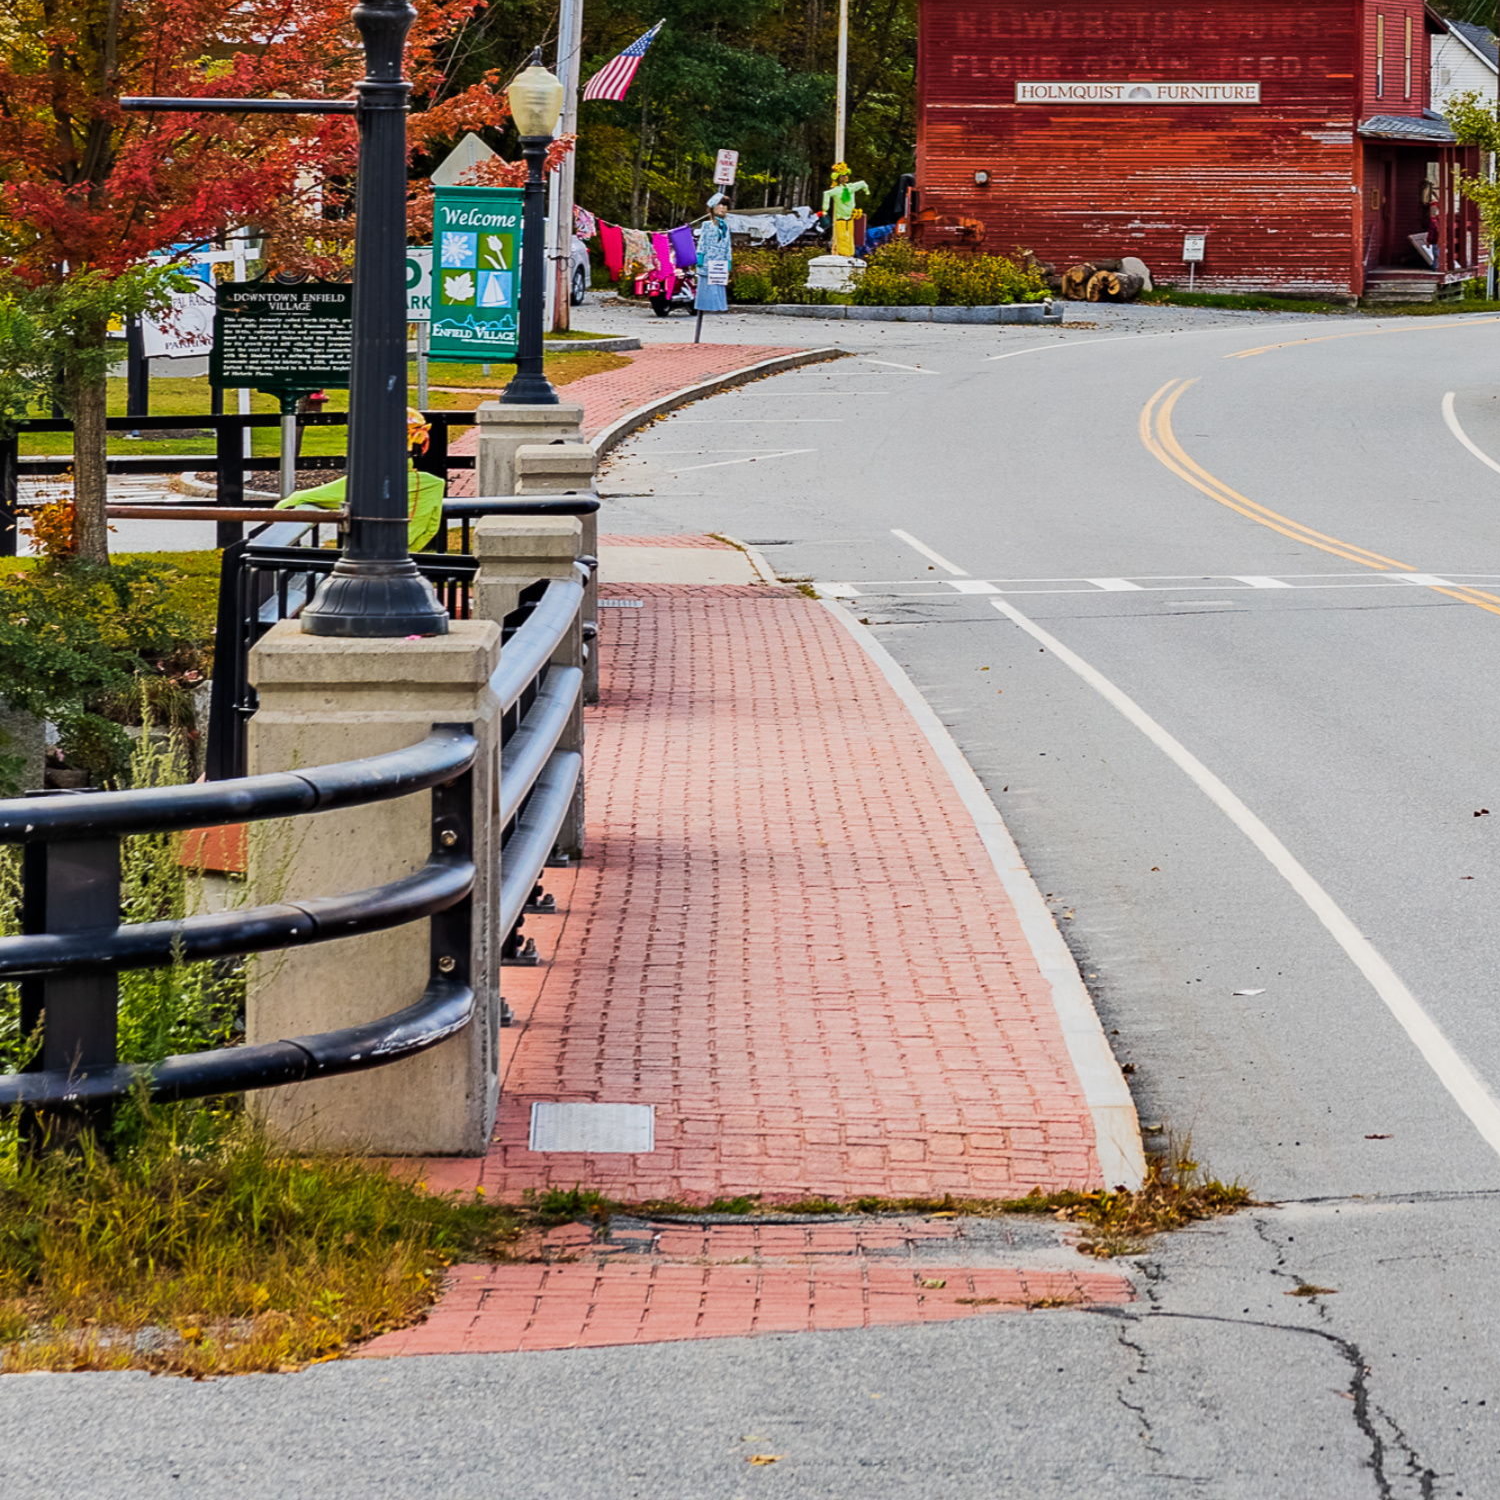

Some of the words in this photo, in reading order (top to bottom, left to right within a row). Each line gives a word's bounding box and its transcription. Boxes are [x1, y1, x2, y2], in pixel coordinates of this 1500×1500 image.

[951, 54, 1061, 79] FLOUR
[1021, 85, 1125, 100] HOLMQUIST
[1157, 85, 1256, 99] FURNITURE
[440, 206, 516, 227] Welcome
[233, 293, 298, 302] DOWNTOWN
[302, 293, 345, 302] ENFIELD
[268, 302, 312, 311] VILLAGE
[432, 323, 473, 338] ENFIELD
[475, 326, 515, 341] VILLAGE
